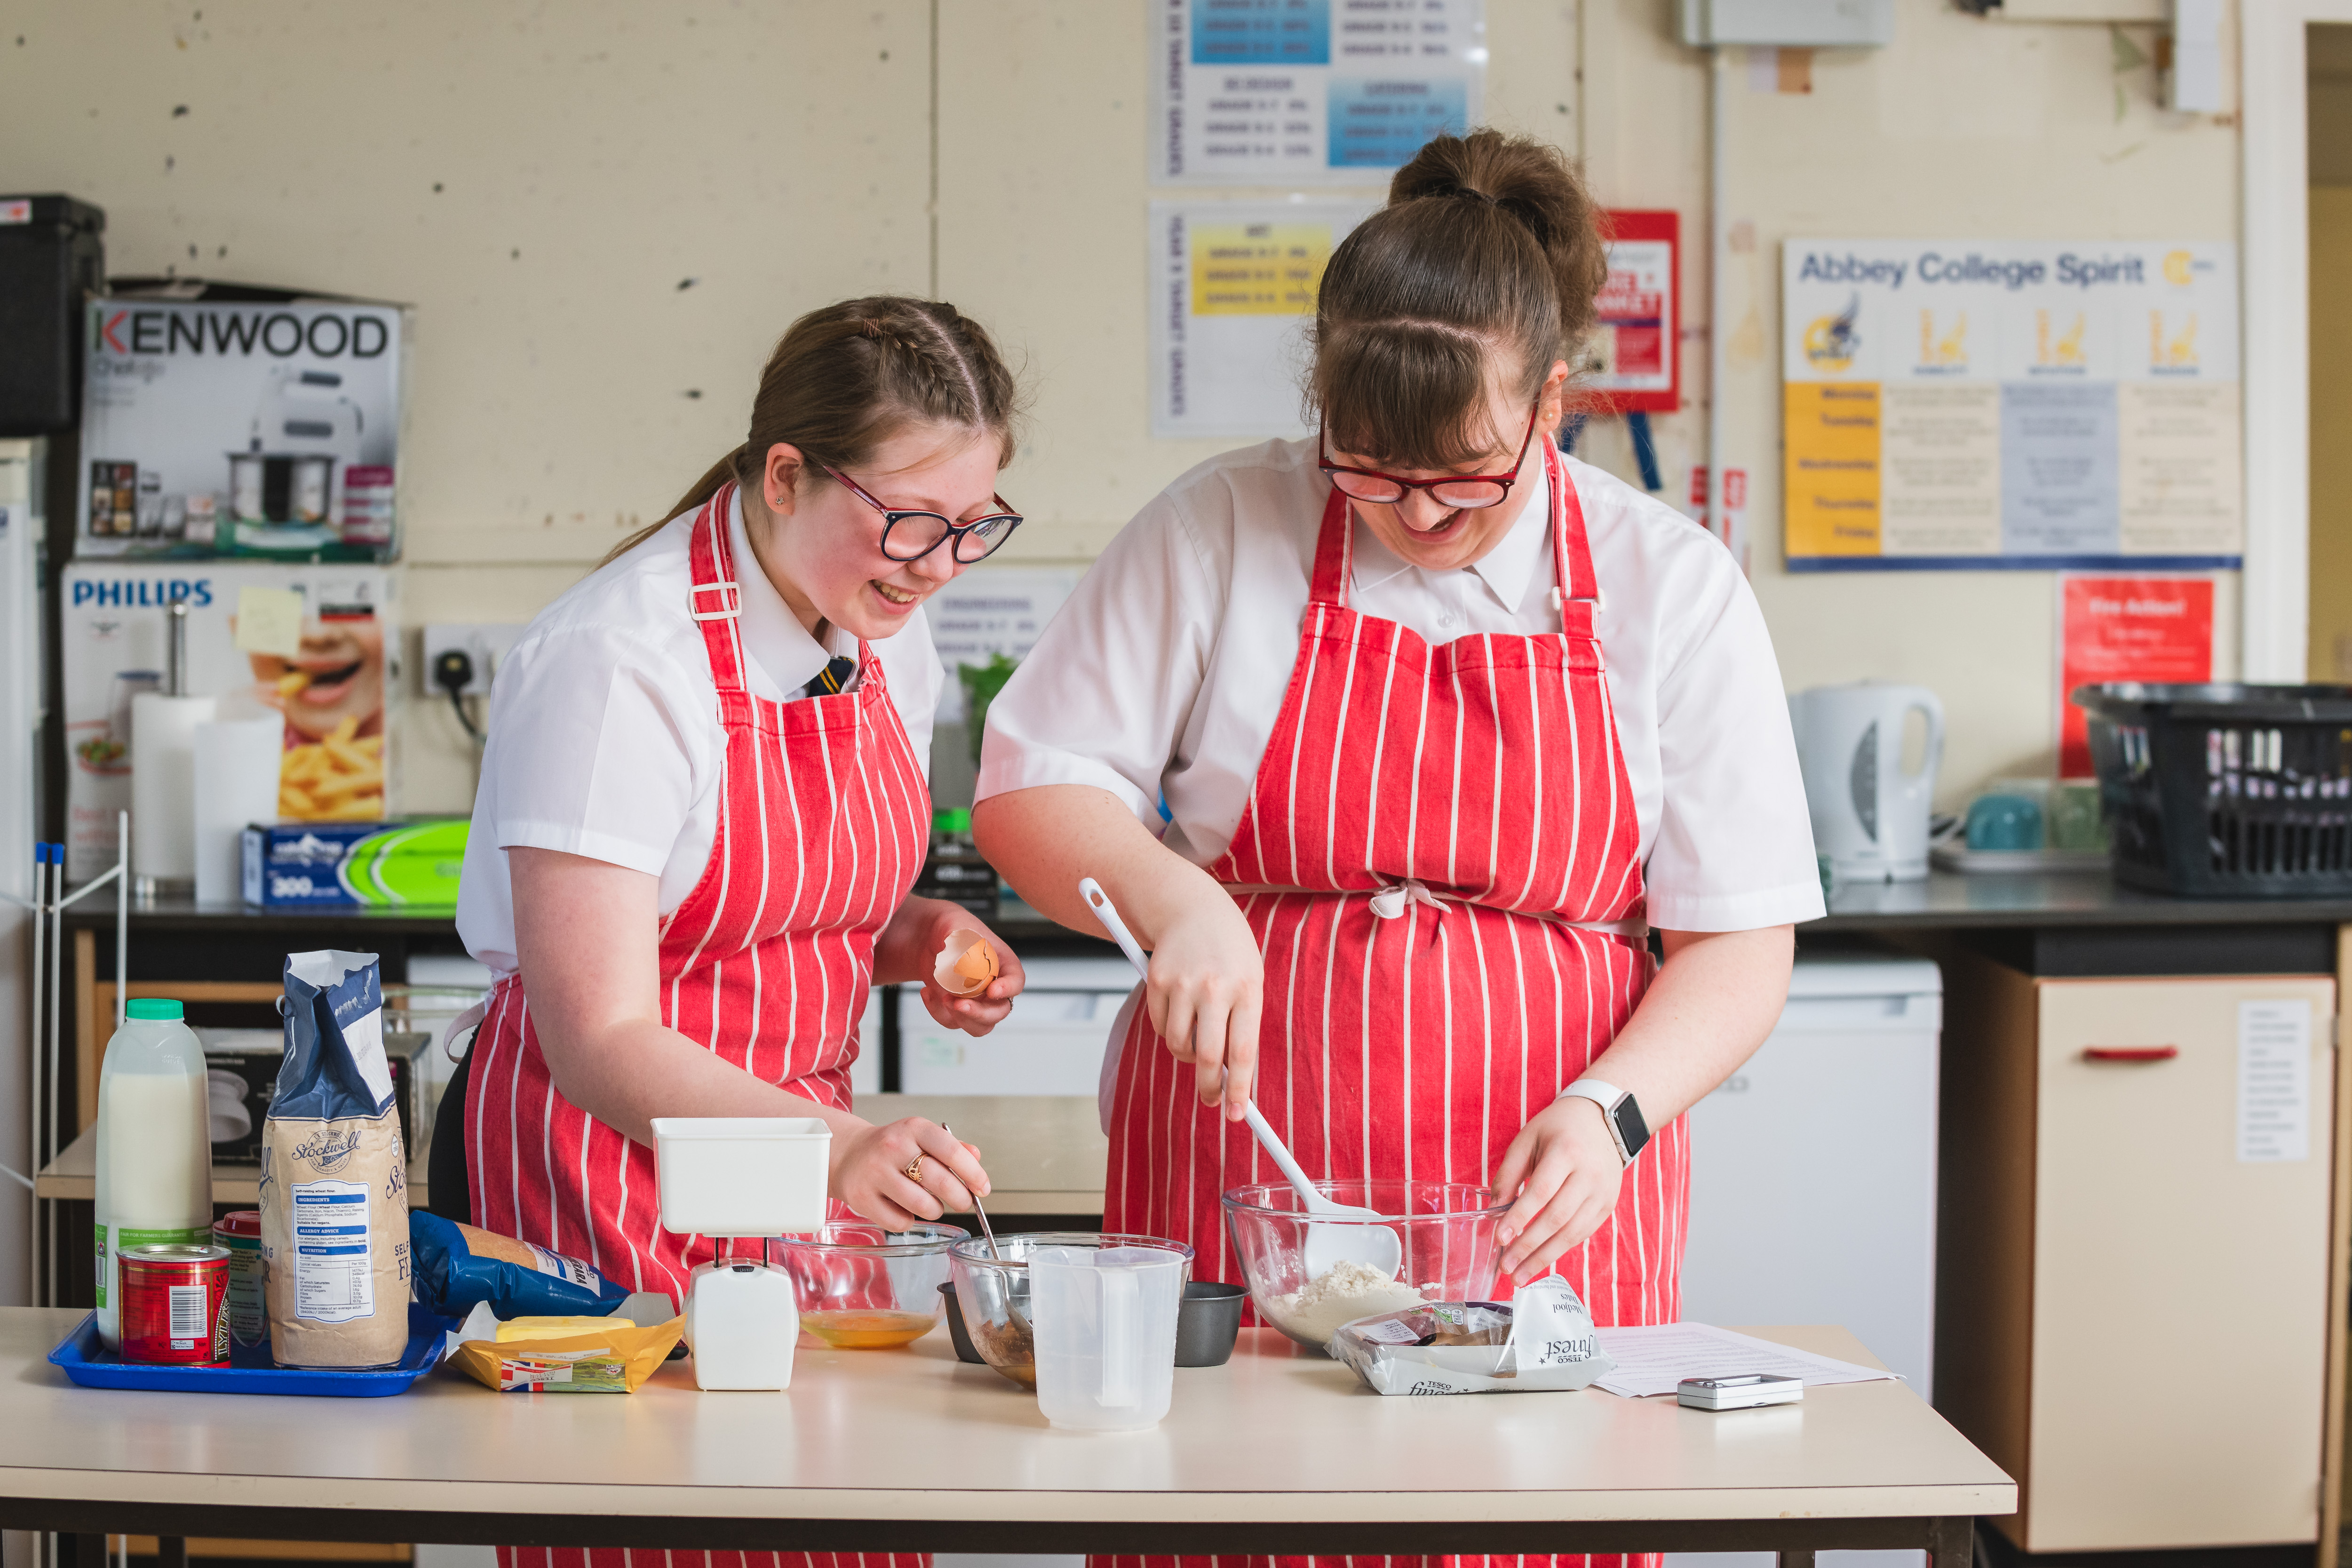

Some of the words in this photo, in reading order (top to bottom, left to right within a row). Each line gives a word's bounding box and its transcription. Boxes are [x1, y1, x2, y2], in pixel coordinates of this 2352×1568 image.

[1799, 253, 1907, 287] Abbey
[1917, 253, 2047, 289] College
[2056, 253, 2145, 287] Spirit
[95, 310, 389, 358] KENWOOD
[72, 579, 213, 608] PHILIPS
[292, 1130, 361, 1160] Stockwell
[338, 1158, 347, 1168] VALUE
[1553, 1303, 1582, 1314] Medjool
[1561, 1294, 1578, 1305] Dates
[218, 1298, 230, 1355] LYLE'S
[1544, 1335, 1593, 1359] finest
[1427, 1380, 1452, 1389] TESCO
